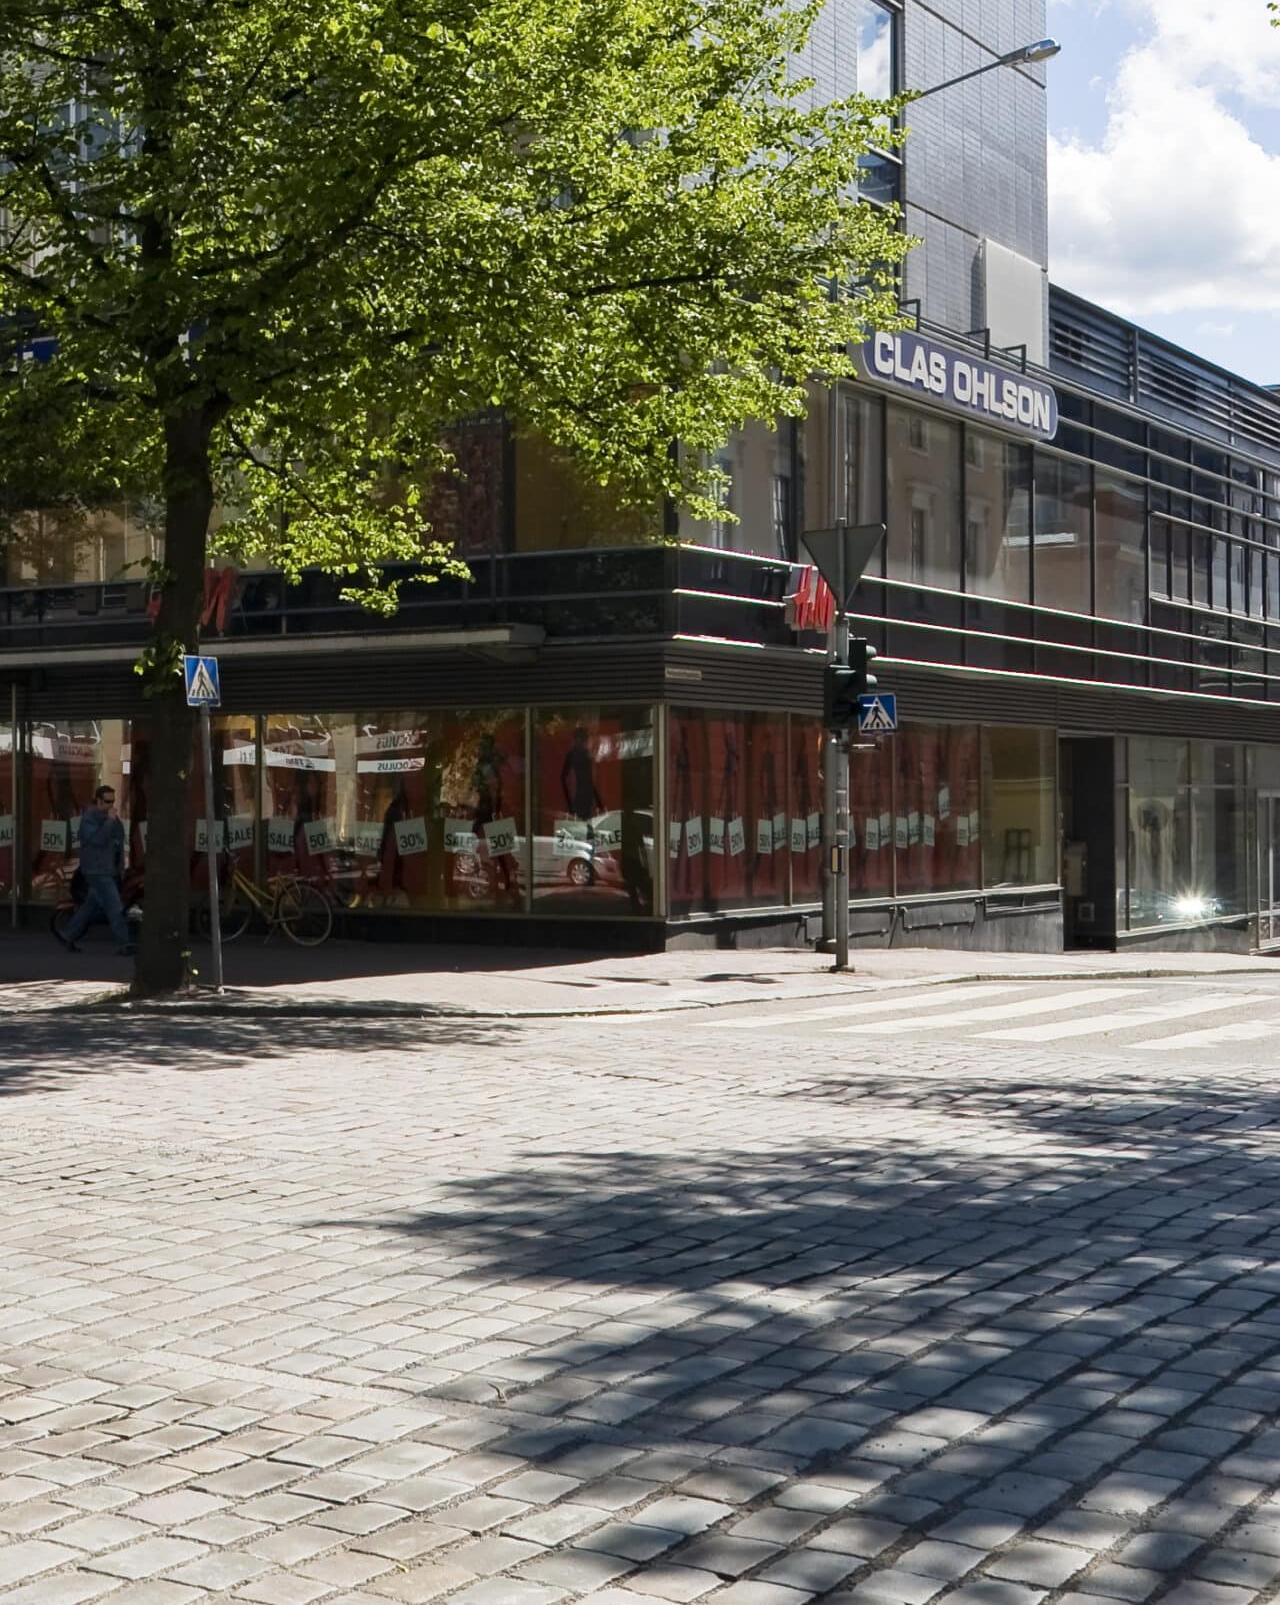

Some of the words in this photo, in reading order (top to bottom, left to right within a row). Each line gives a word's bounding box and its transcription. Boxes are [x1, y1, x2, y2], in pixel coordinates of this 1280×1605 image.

[874, 331, 947, 394] CLAS
[953, 360, 1050, 431] OHLSON
[43, 832, 65, 846] 50%
[228, 827, 252, 843] SALE
[270, 832, 295, 846] SALE
[400, 831, 425, 849] 30%
[489, 831, 515, 850] 50%
